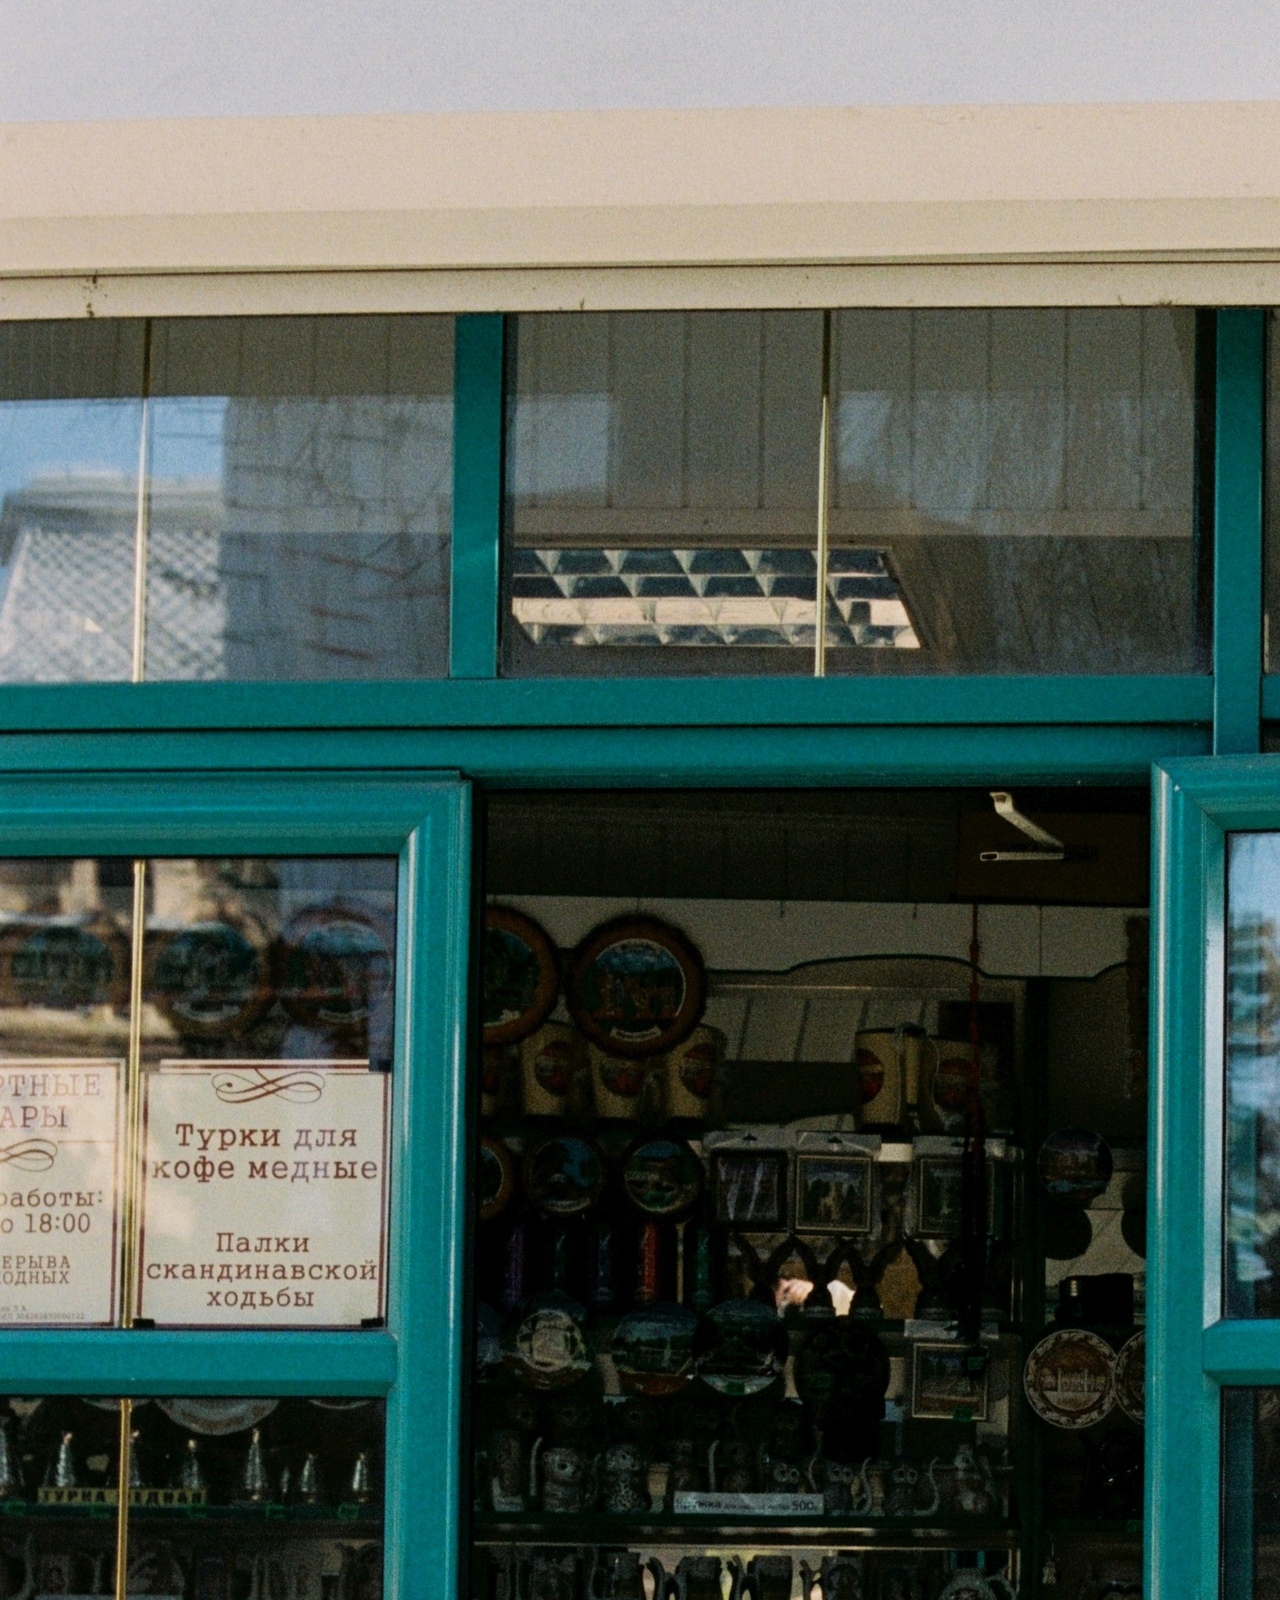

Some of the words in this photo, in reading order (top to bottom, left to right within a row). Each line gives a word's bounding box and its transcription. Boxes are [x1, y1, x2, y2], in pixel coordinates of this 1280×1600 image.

[175, 1123, 281, 1149] Турки
[294, 1129, 358, 1150] для
[152, 1156, 235, 1183] кофе
[248, 1160, 379, 1183] медные
[24, 1212, 91, 1234] 18:00
[216, 1232, 310, 1253] Палки
[2, 1255, 71, 1269] ЕРЫВА
[146, 1259, 377, 1281] скандинавской
[206, 1287, 315, 1308] ходьбы
